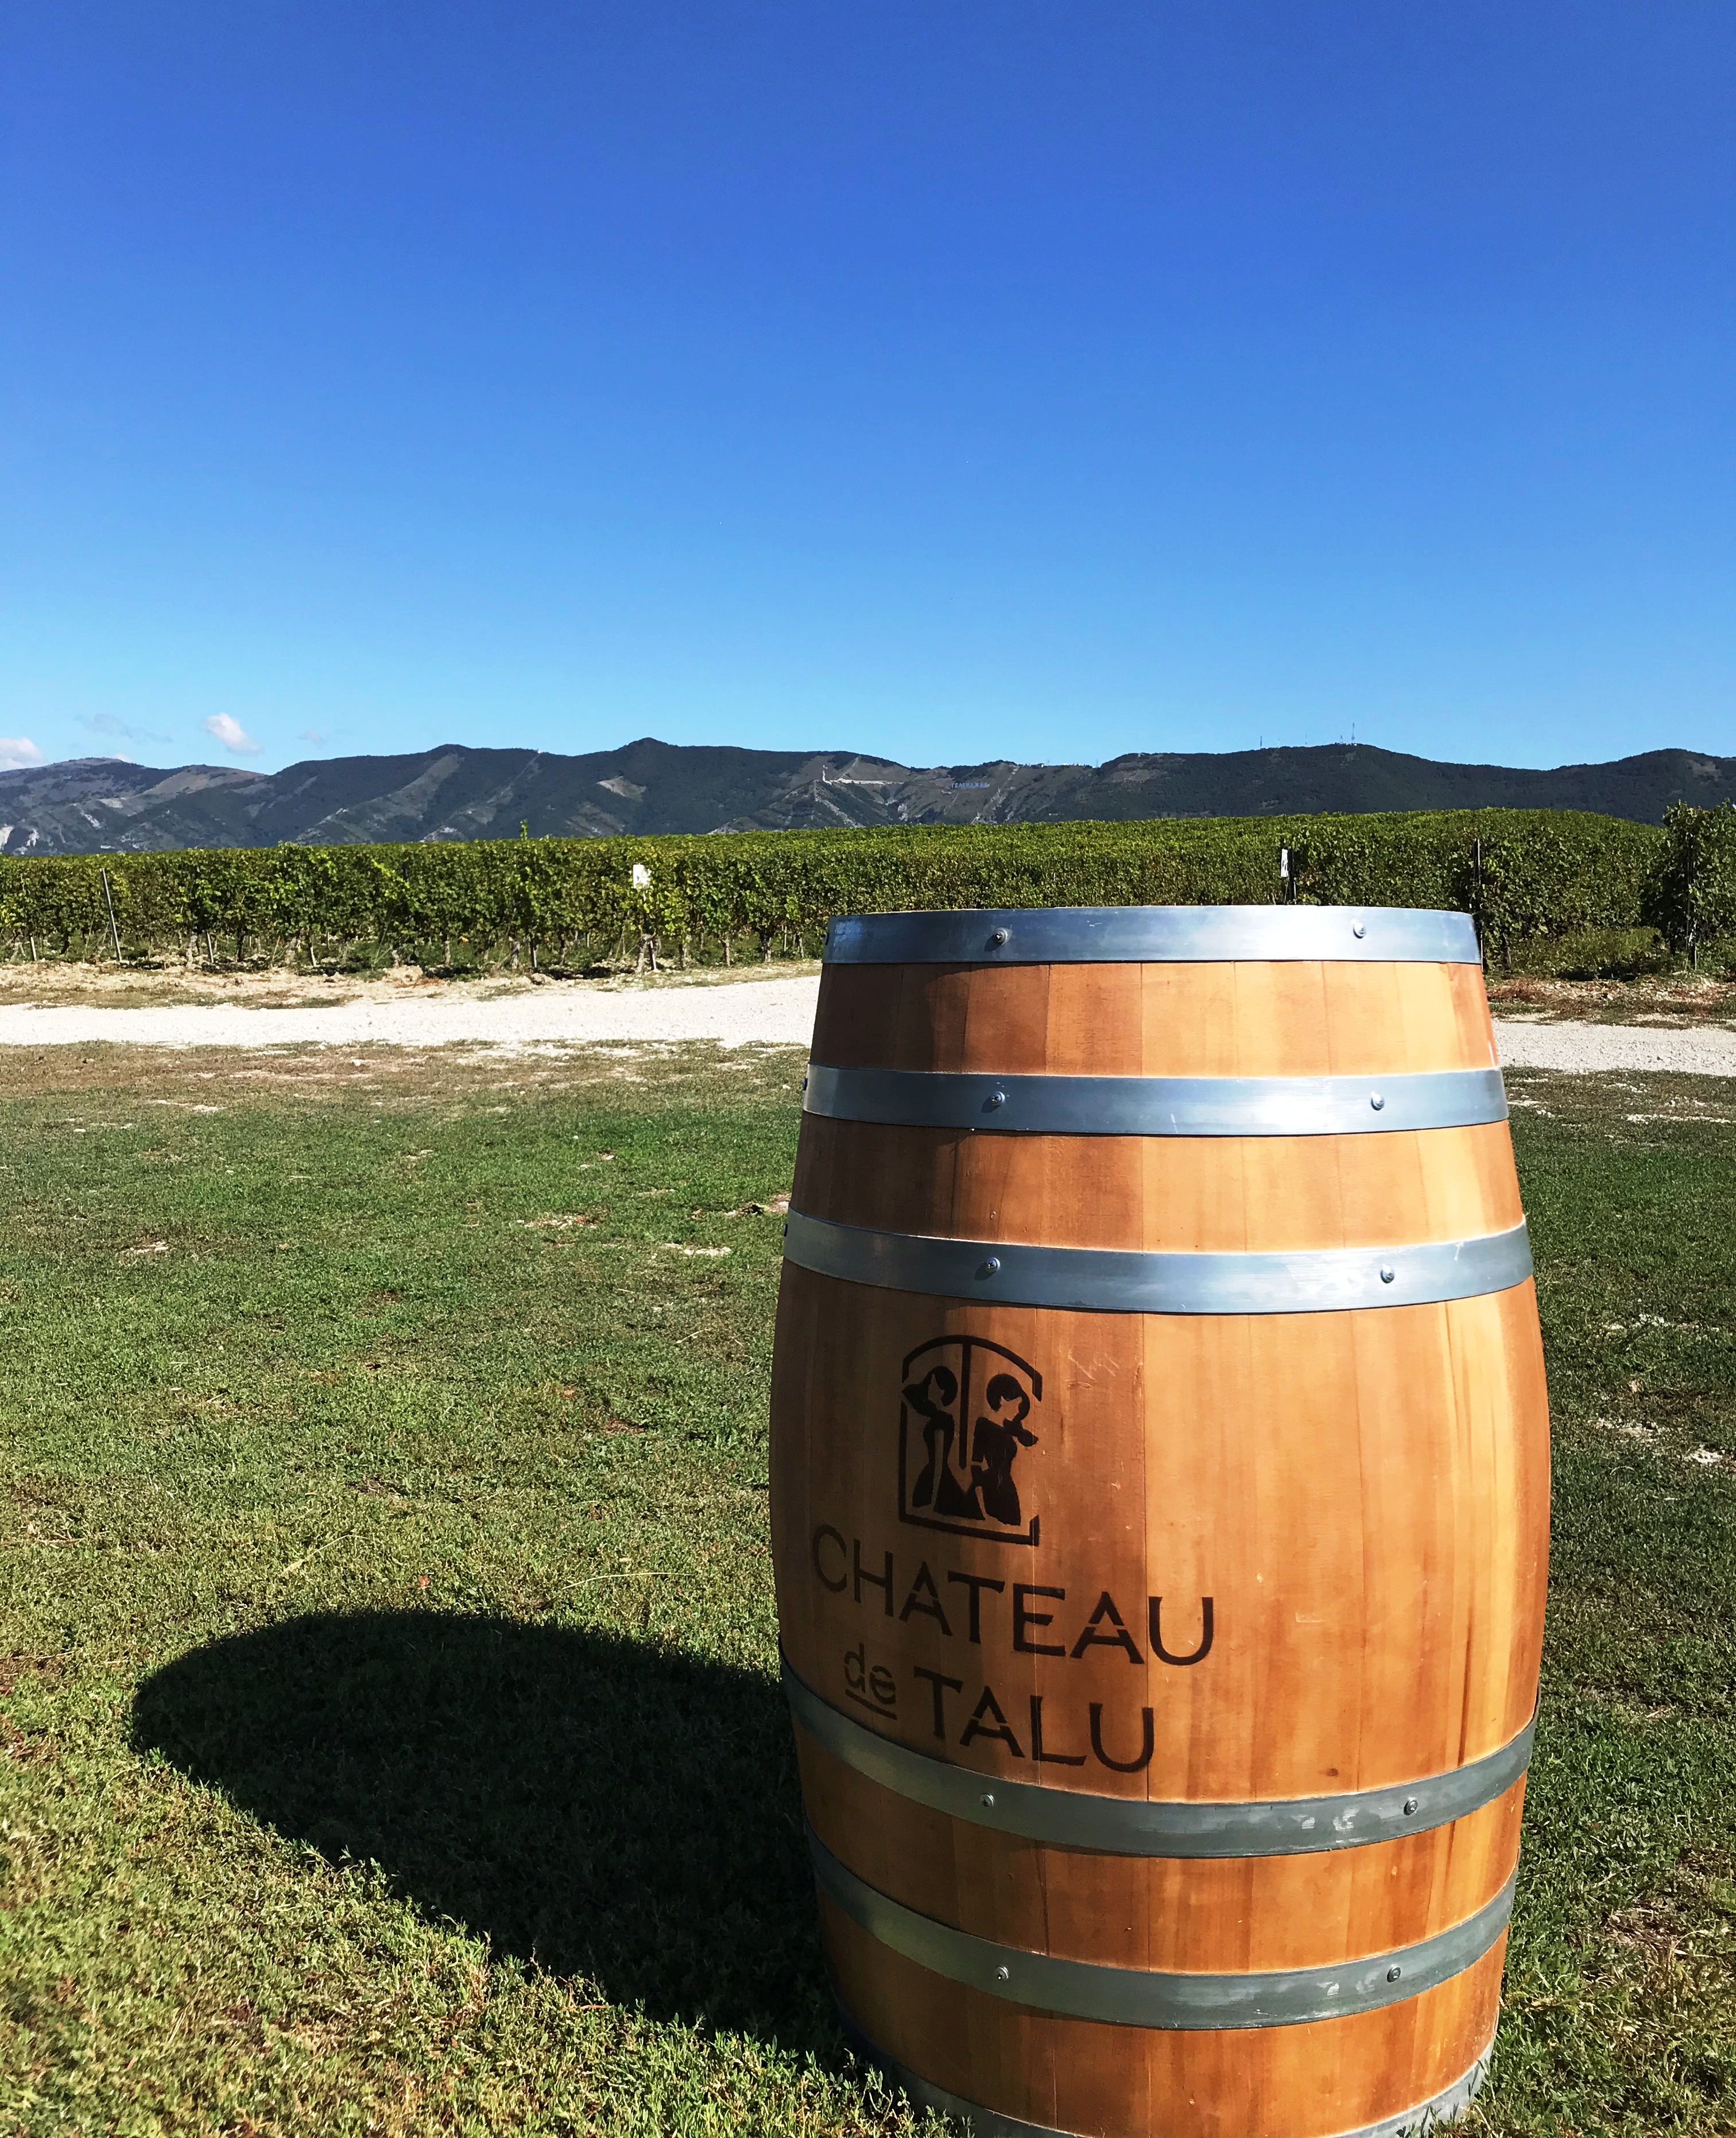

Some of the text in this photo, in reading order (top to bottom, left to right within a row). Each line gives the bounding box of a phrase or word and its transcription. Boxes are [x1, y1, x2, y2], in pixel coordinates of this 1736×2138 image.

[812, 1524, 1214, 1666] CHATEAU
[844, 1643, 1155, 1773] de TALU
